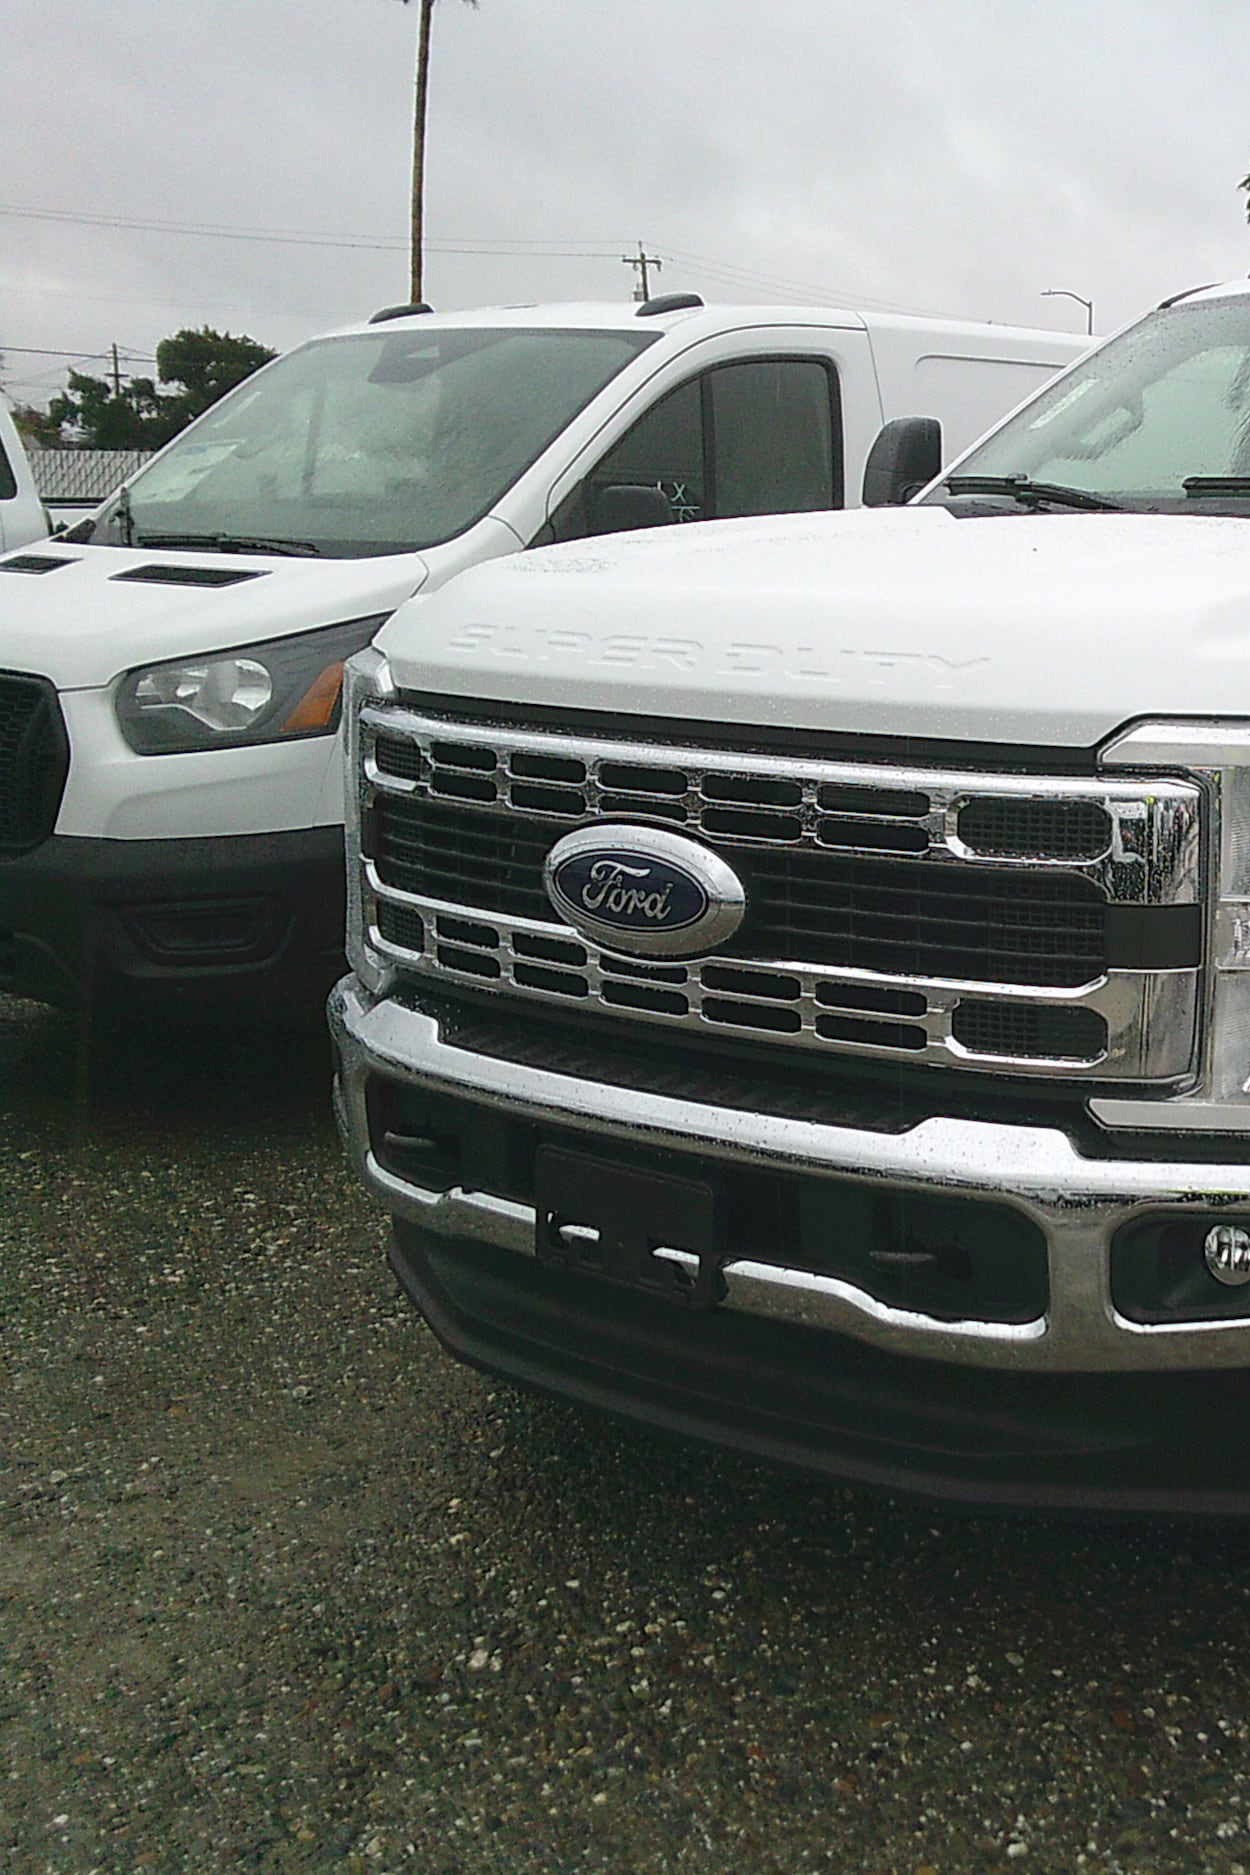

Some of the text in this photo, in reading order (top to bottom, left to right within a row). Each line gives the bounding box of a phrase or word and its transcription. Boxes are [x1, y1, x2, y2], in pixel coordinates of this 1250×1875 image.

[445, 623, 991, 689] SUPER DUTY
[582, 860, 675, 920] Ford
